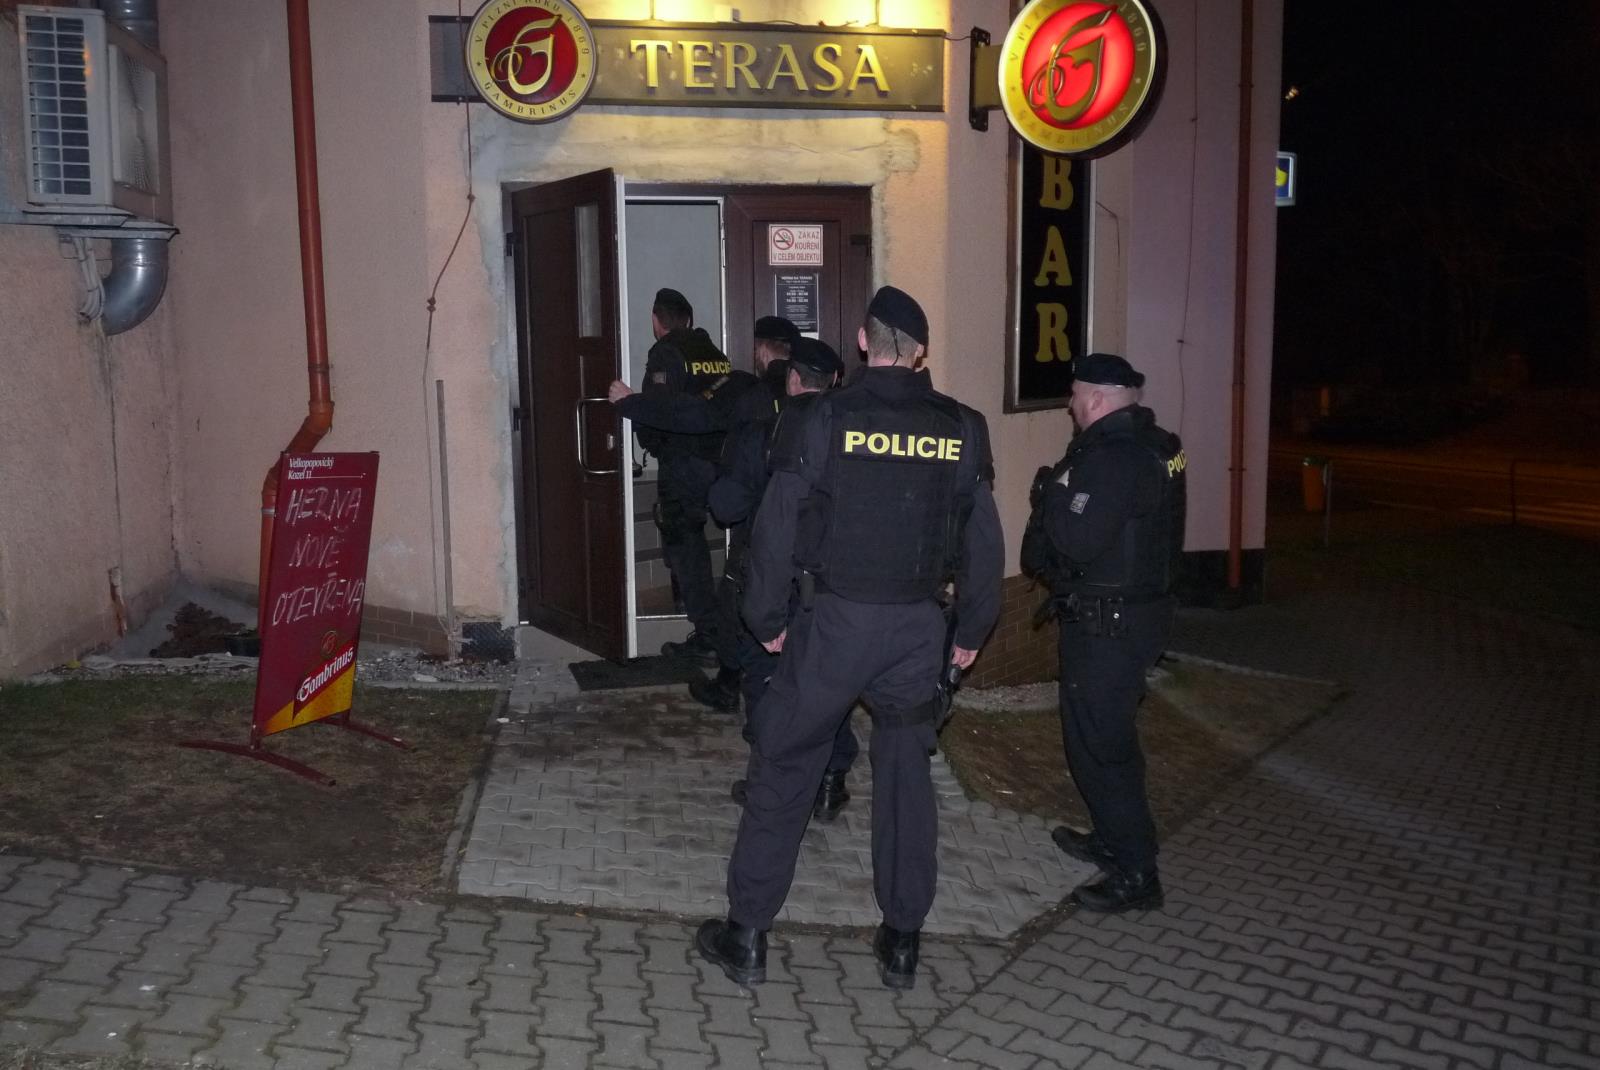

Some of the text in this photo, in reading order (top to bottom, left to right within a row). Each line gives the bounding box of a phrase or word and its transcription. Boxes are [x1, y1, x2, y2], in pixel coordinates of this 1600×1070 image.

[630, 39, 891, 92] TERASA
[484, 81, 577, 116] GAMBRINUS
[1034, 156, 1074, 363] BAR
[844, 431, 962, 461] POLICIE
[1167, 449, 1187, 478] POL
[288, 470, 305, 480] Kozel
[285, 486, 362, 527] HERNA
[296, 647, 354, 702] Gambrinus
